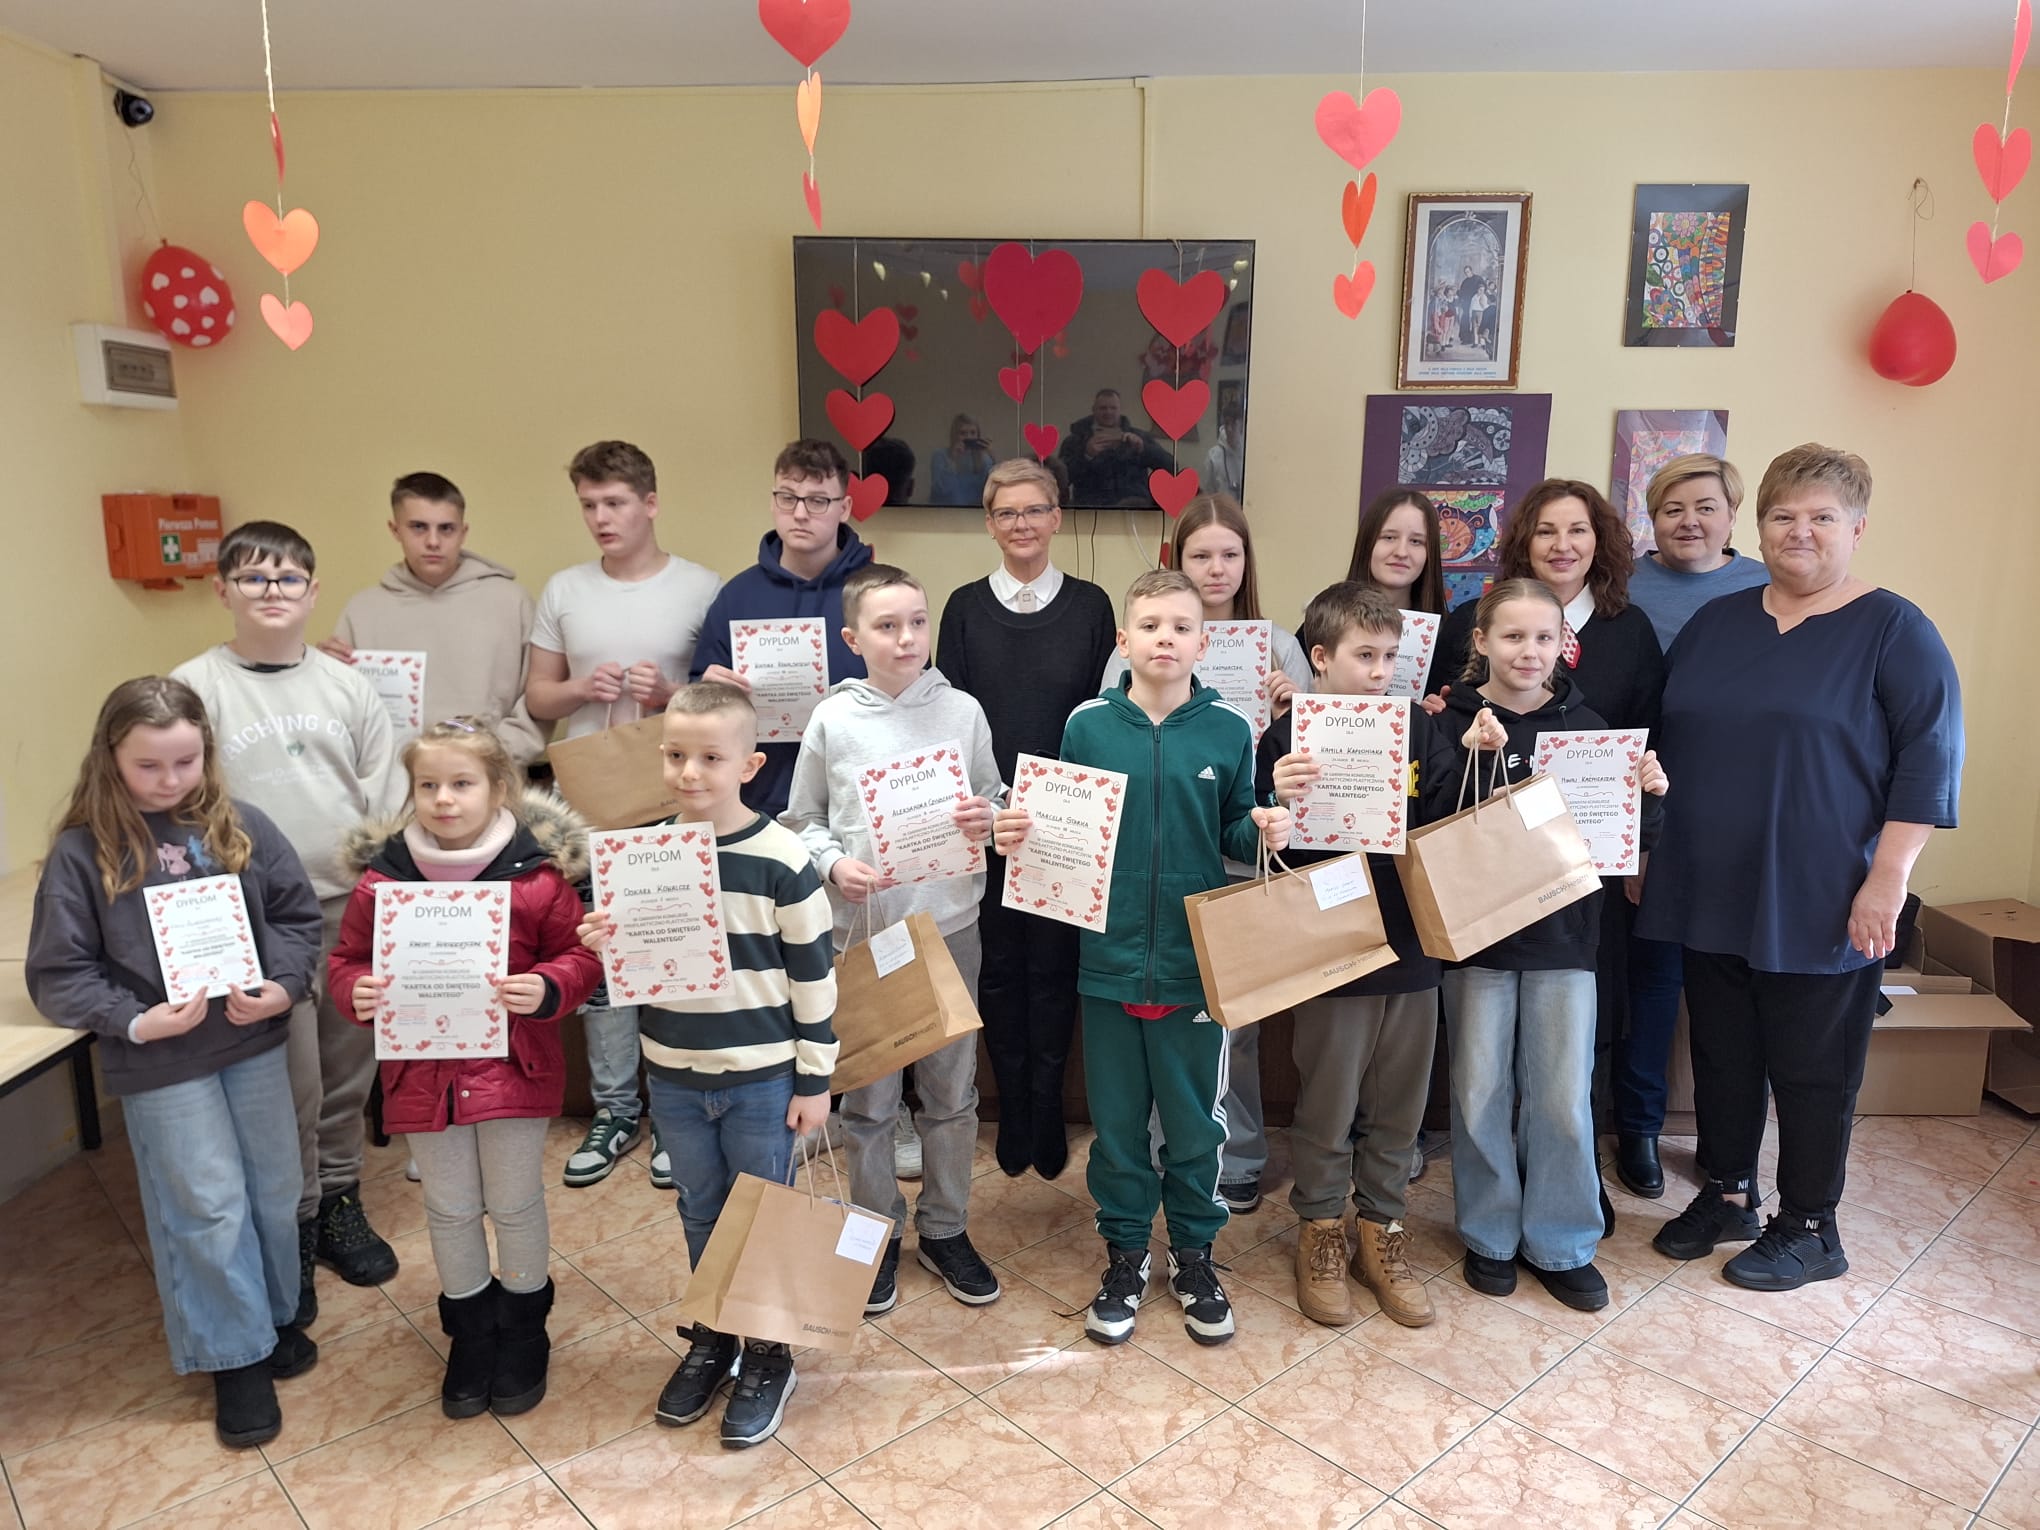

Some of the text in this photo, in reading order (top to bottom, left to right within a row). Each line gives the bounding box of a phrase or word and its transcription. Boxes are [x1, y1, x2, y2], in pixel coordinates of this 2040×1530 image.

[760, 636, 800, 647] DYPLOM
[1325, 716, 1376, 728] DYPLOM
[1566, 748, 1614, 760] DYPLOM
[889, 767, 937, 790] DYPLOM
[1045, 781, 1092, 800] DYPLOM
[628, 850, 681, 866] DYPLOM
[175, 894, 217, 909] DYPLOM
[415, 906, 472, 918] DYPLOM
